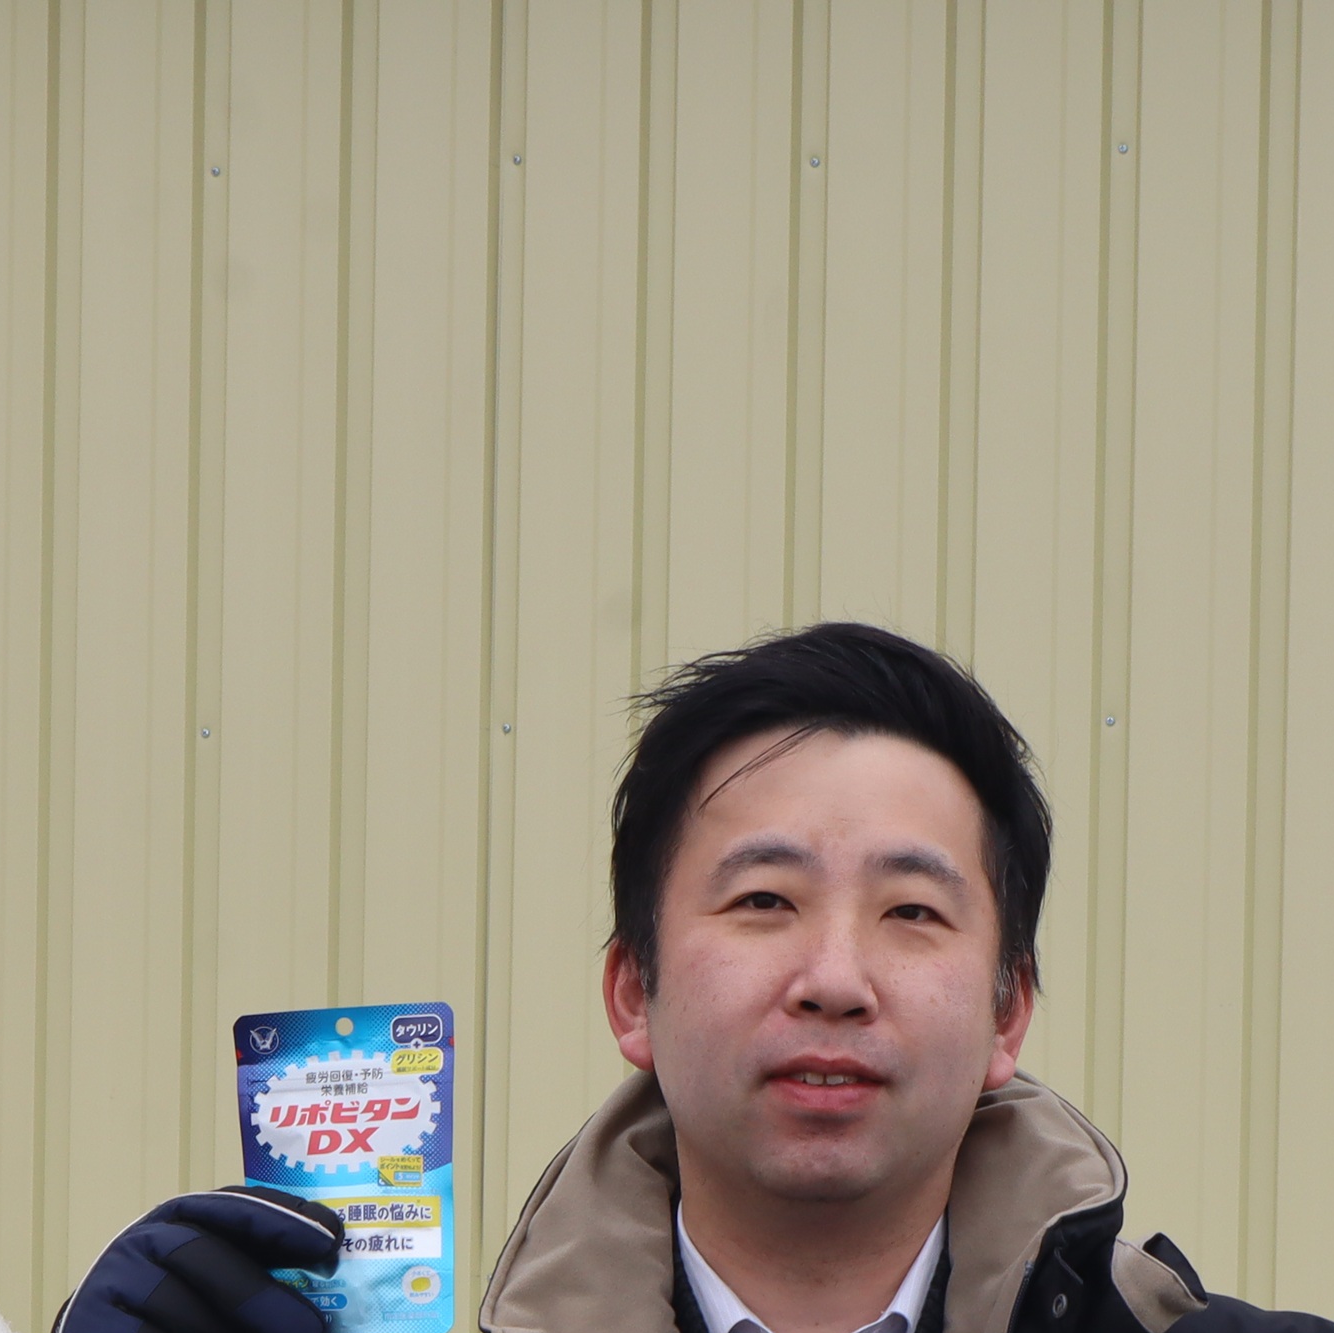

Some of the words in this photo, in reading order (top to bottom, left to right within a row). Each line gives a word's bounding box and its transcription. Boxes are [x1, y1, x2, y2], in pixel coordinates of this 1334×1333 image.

[396, 1023, 438, 1037] タウリン
[396, 1053, 438, 1065] グリシン
[305, 1068, 384, 1084] 疲労回復・予防
[321, 1082, 369, 1097] 栄養補給
[269, 1097, 421, 1128] リポビタン
[307, 1127, 380, 1156] DX
[343, 1235, 414, 1252] その疲れに
